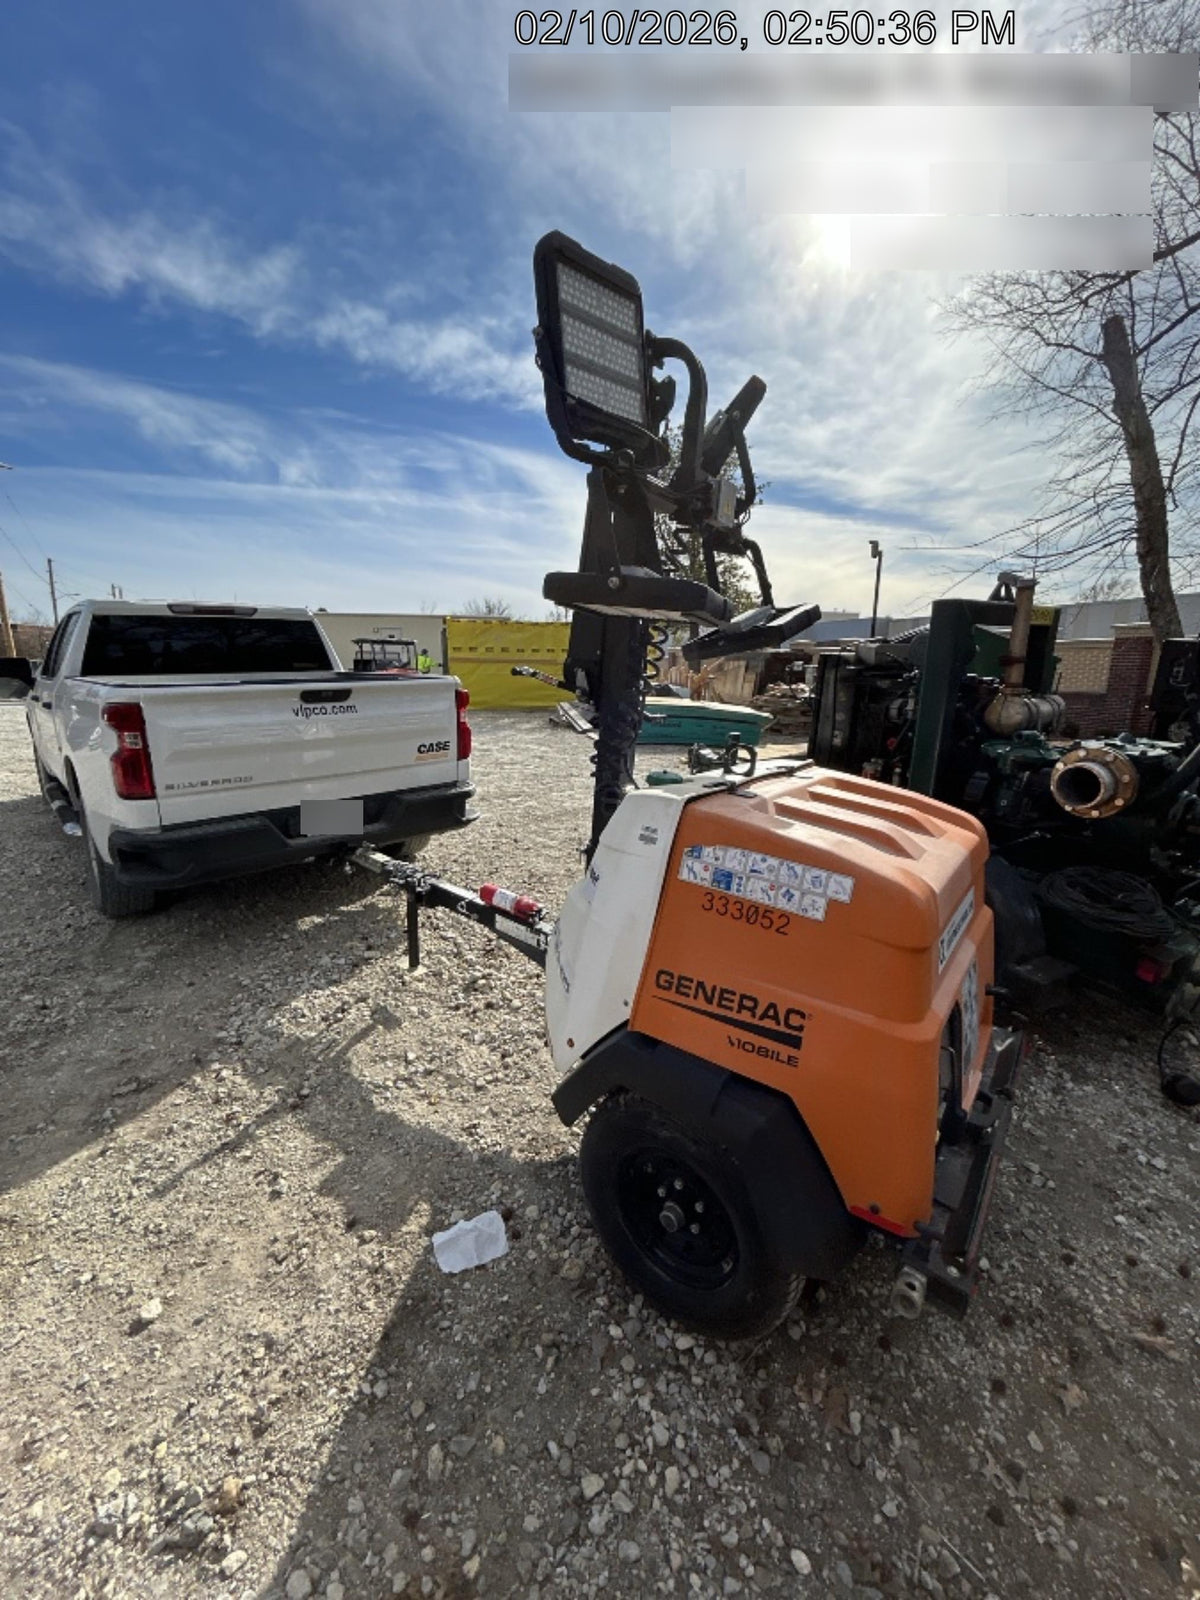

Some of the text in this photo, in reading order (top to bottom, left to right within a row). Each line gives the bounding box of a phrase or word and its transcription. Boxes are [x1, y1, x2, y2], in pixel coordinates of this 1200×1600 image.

[417, 741, 450, 754] CASE
[701, 891, 791, 936] 333052
[655, 968, 806, 1034] GENERAC
